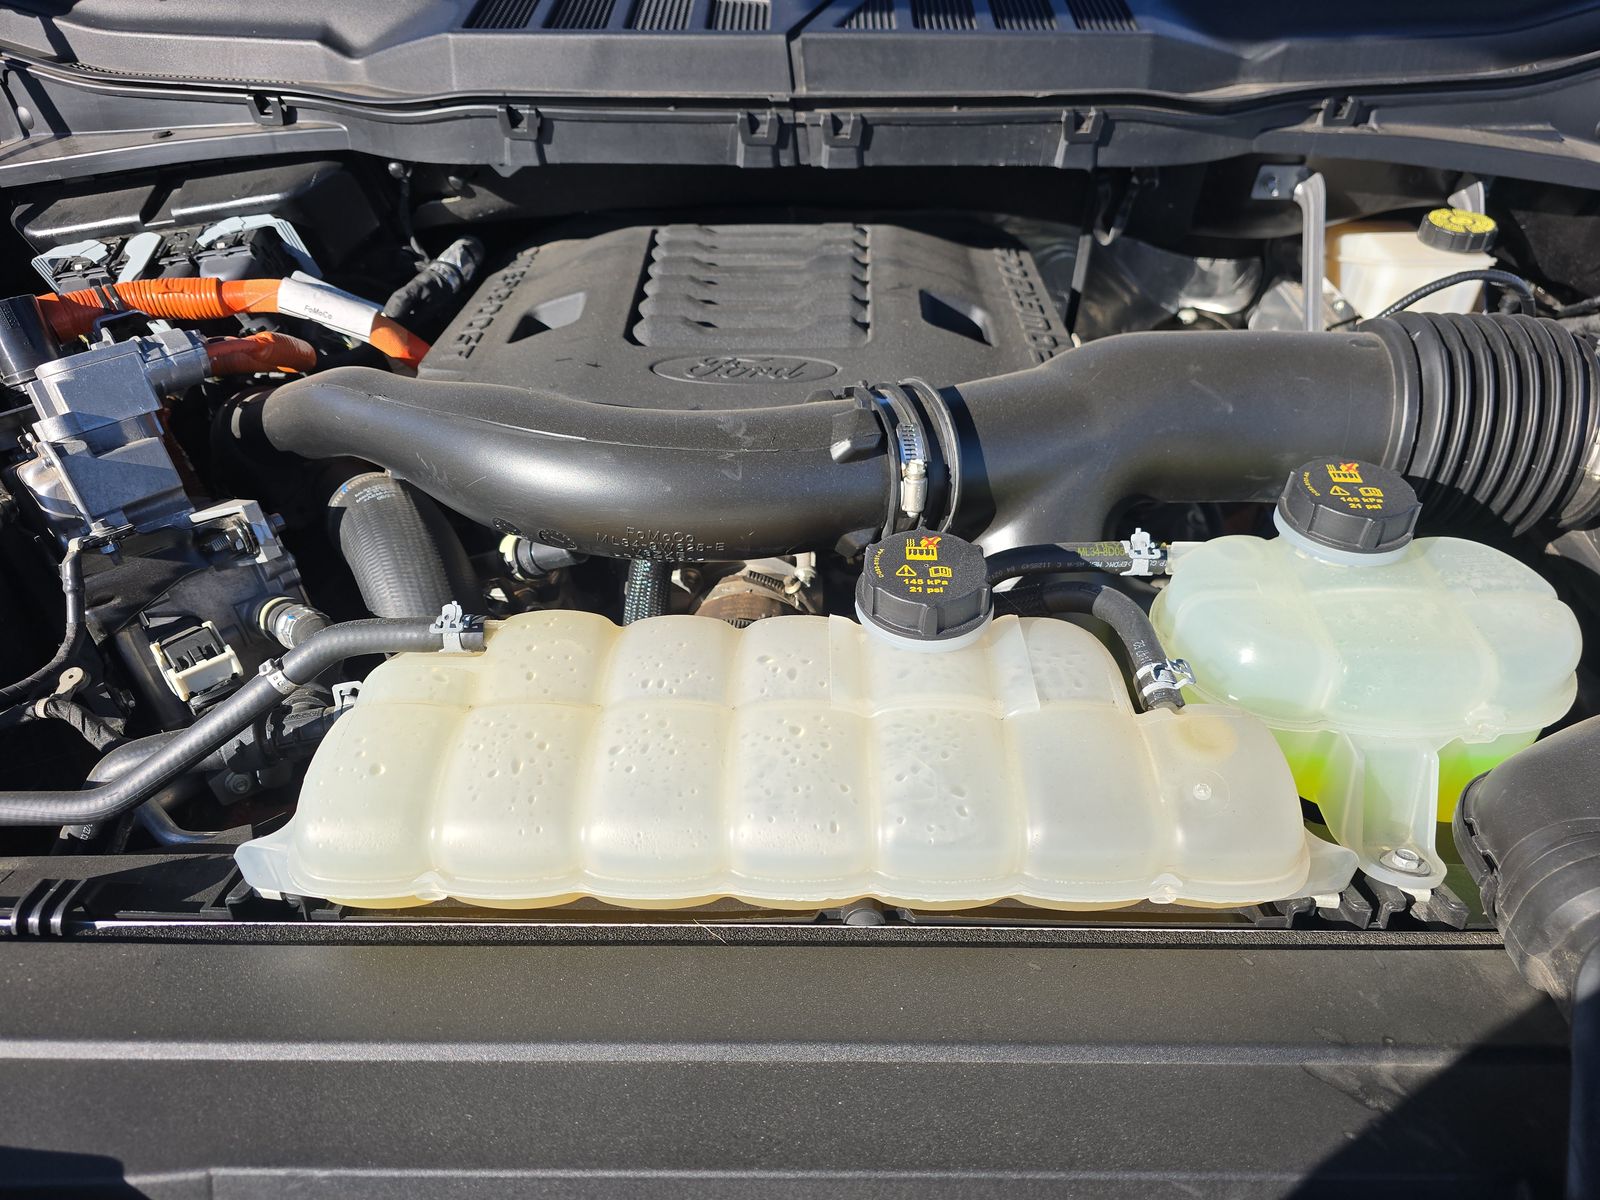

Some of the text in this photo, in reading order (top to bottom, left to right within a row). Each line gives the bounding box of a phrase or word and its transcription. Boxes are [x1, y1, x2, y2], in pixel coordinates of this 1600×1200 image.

[304, 304, 333, 320] FoMoCo
[689, 356, 808, 379] Ford
[626, 526, 694, 543] FoMoCo
[926, 578, 949, 586] kPa
[926, 586, 944, 594] psi
